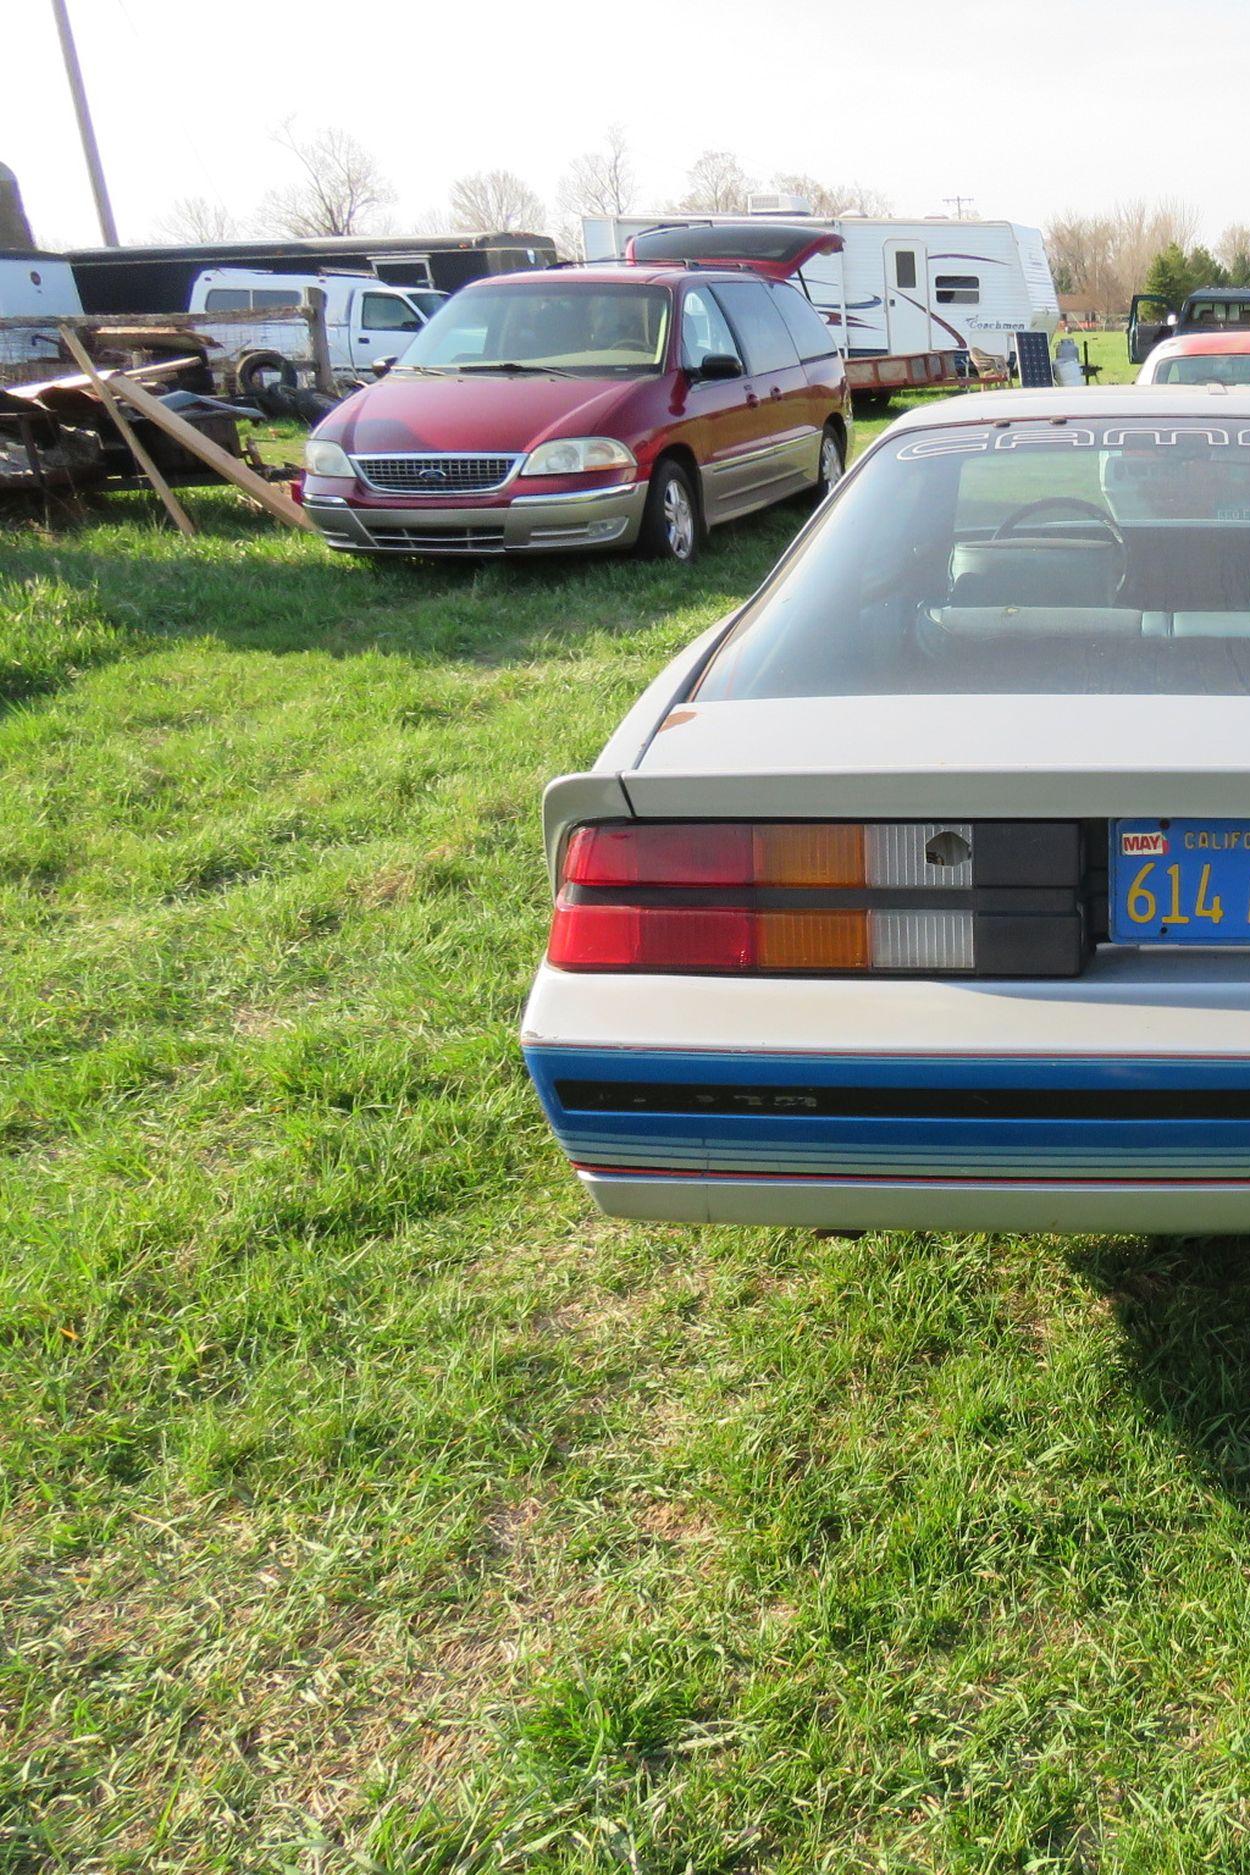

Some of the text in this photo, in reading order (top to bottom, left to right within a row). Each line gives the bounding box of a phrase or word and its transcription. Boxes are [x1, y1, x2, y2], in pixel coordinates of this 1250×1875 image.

[969, 319, 1025, 330] Coachmen
[1123, 835, 1162, 851] MAY
[1126, 862, 1224, 924] 614
